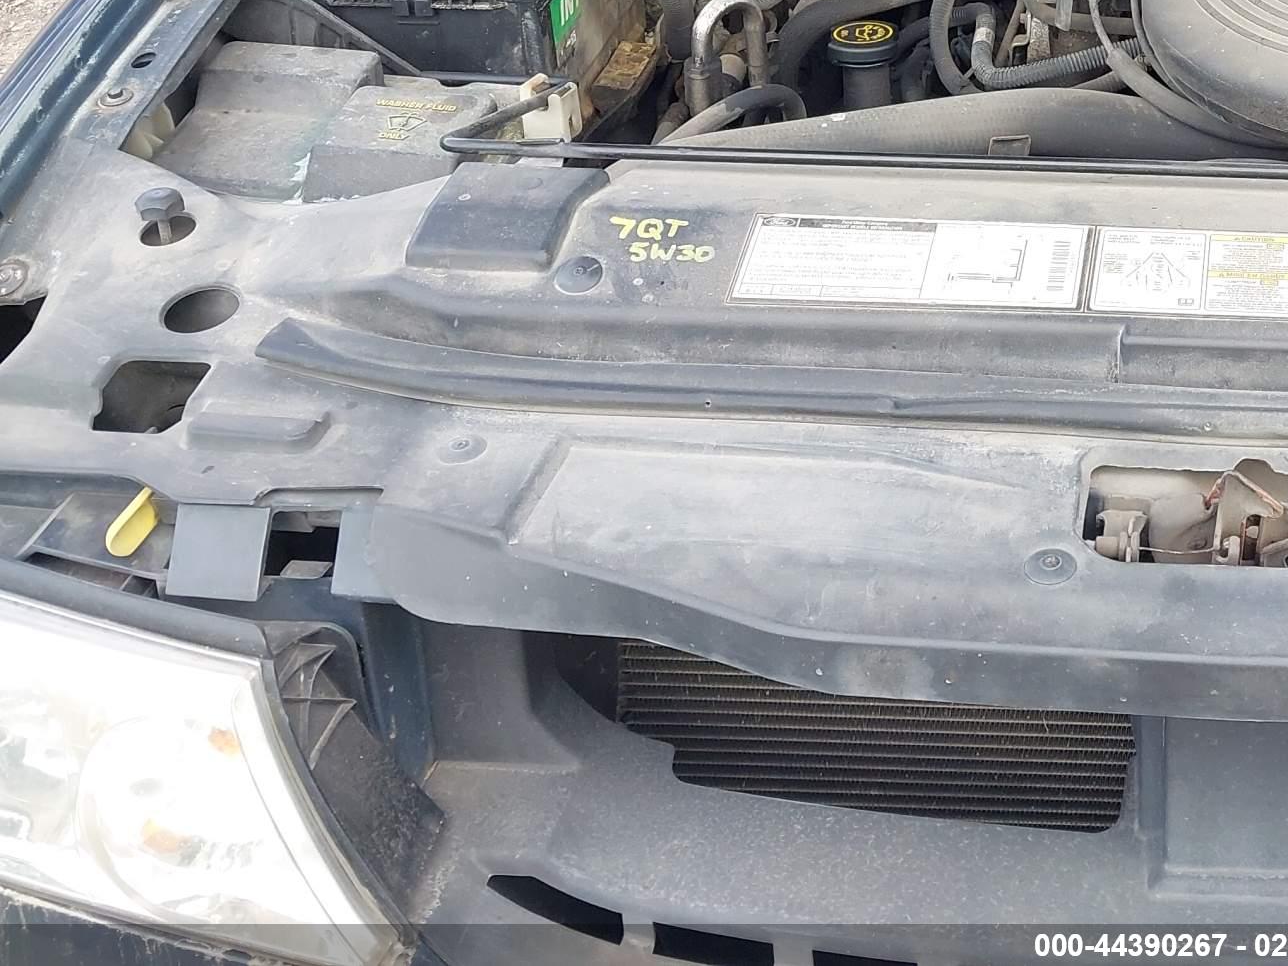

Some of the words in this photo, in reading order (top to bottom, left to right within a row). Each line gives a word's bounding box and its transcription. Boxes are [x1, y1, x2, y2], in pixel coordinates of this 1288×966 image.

[376, 99, 423, 109] WASHER
[425, 103, 457, 112] FLUID
[379, 132, 410, 141] ONLY
[609, 216, 689, 240] 7QT
[629, 242, 715, 262] 5W30
